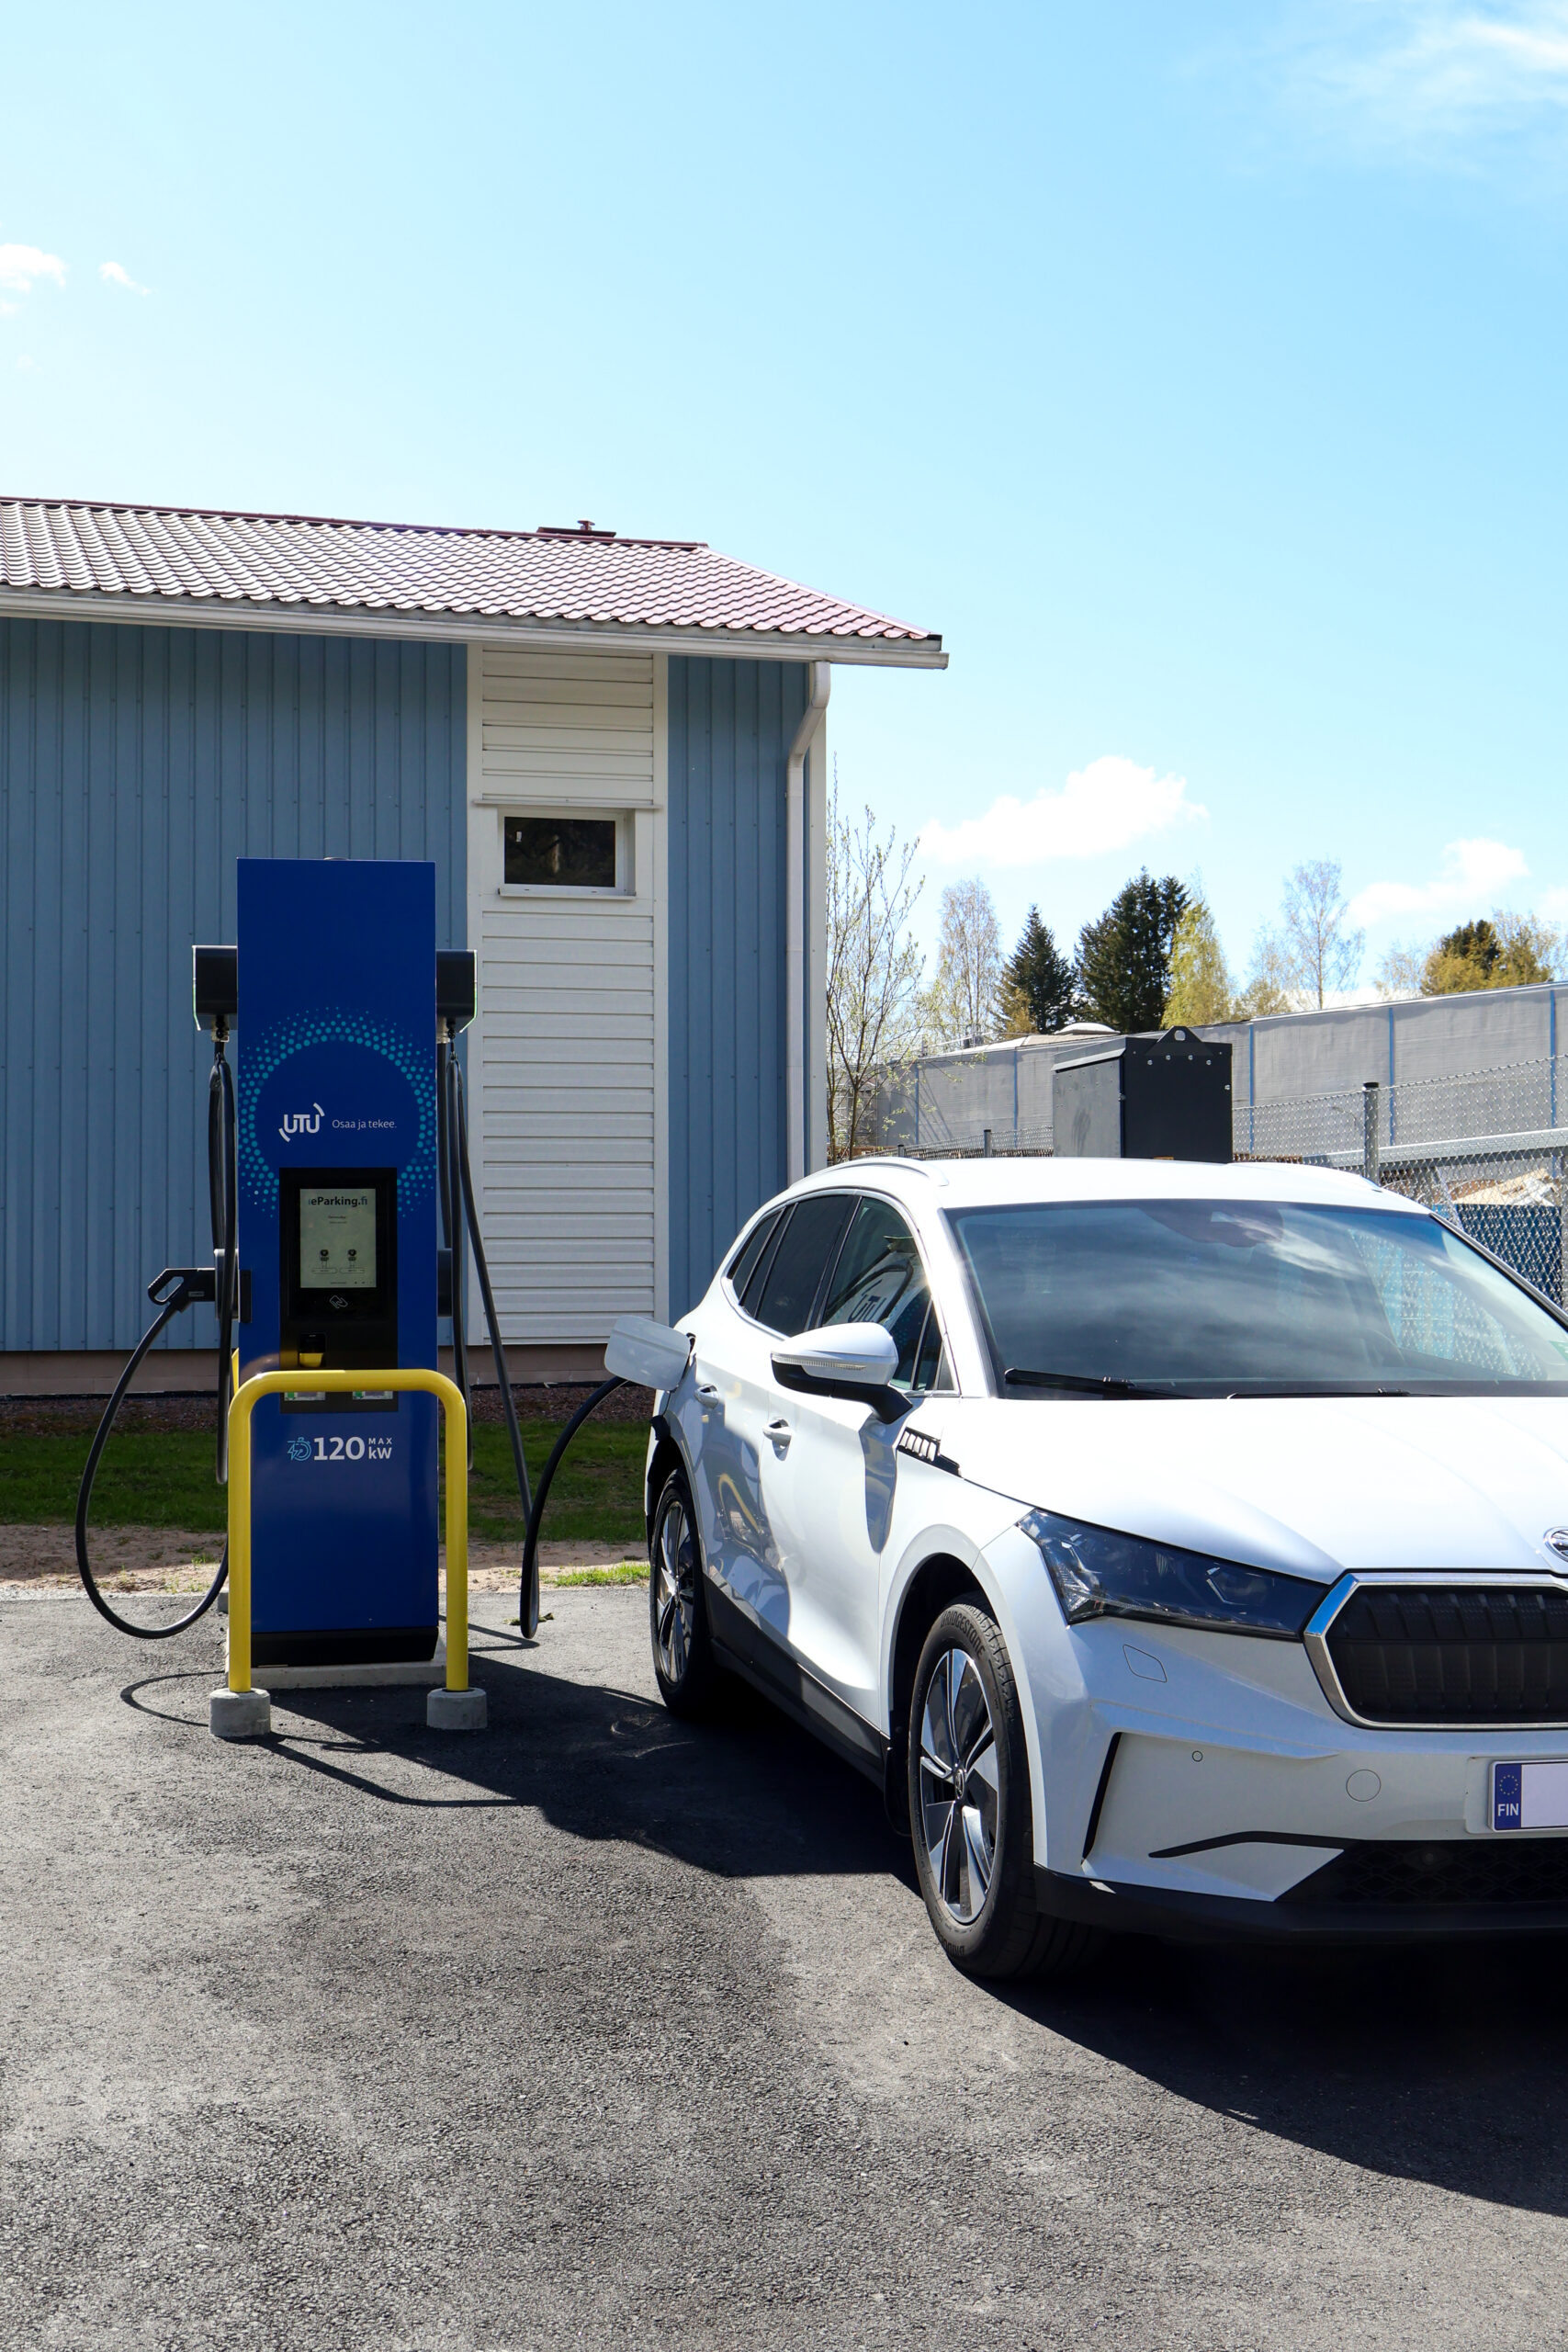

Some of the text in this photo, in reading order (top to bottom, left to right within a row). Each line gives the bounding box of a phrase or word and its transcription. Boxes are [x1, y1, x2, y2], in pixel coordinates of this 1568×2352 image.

[283, 1114, 321, 1134] UTU
[332, 1119, 398, 1130] Osaa ja tekee.
[310, 1196, 368, 1208] eParking.fi
[368, 1437, 392, 1445] MAX
[313, 1436, 366, 1461] 120
[368, 1446, 392, 1460] kW
[1497, 1803, 1519, 1817] FIN
